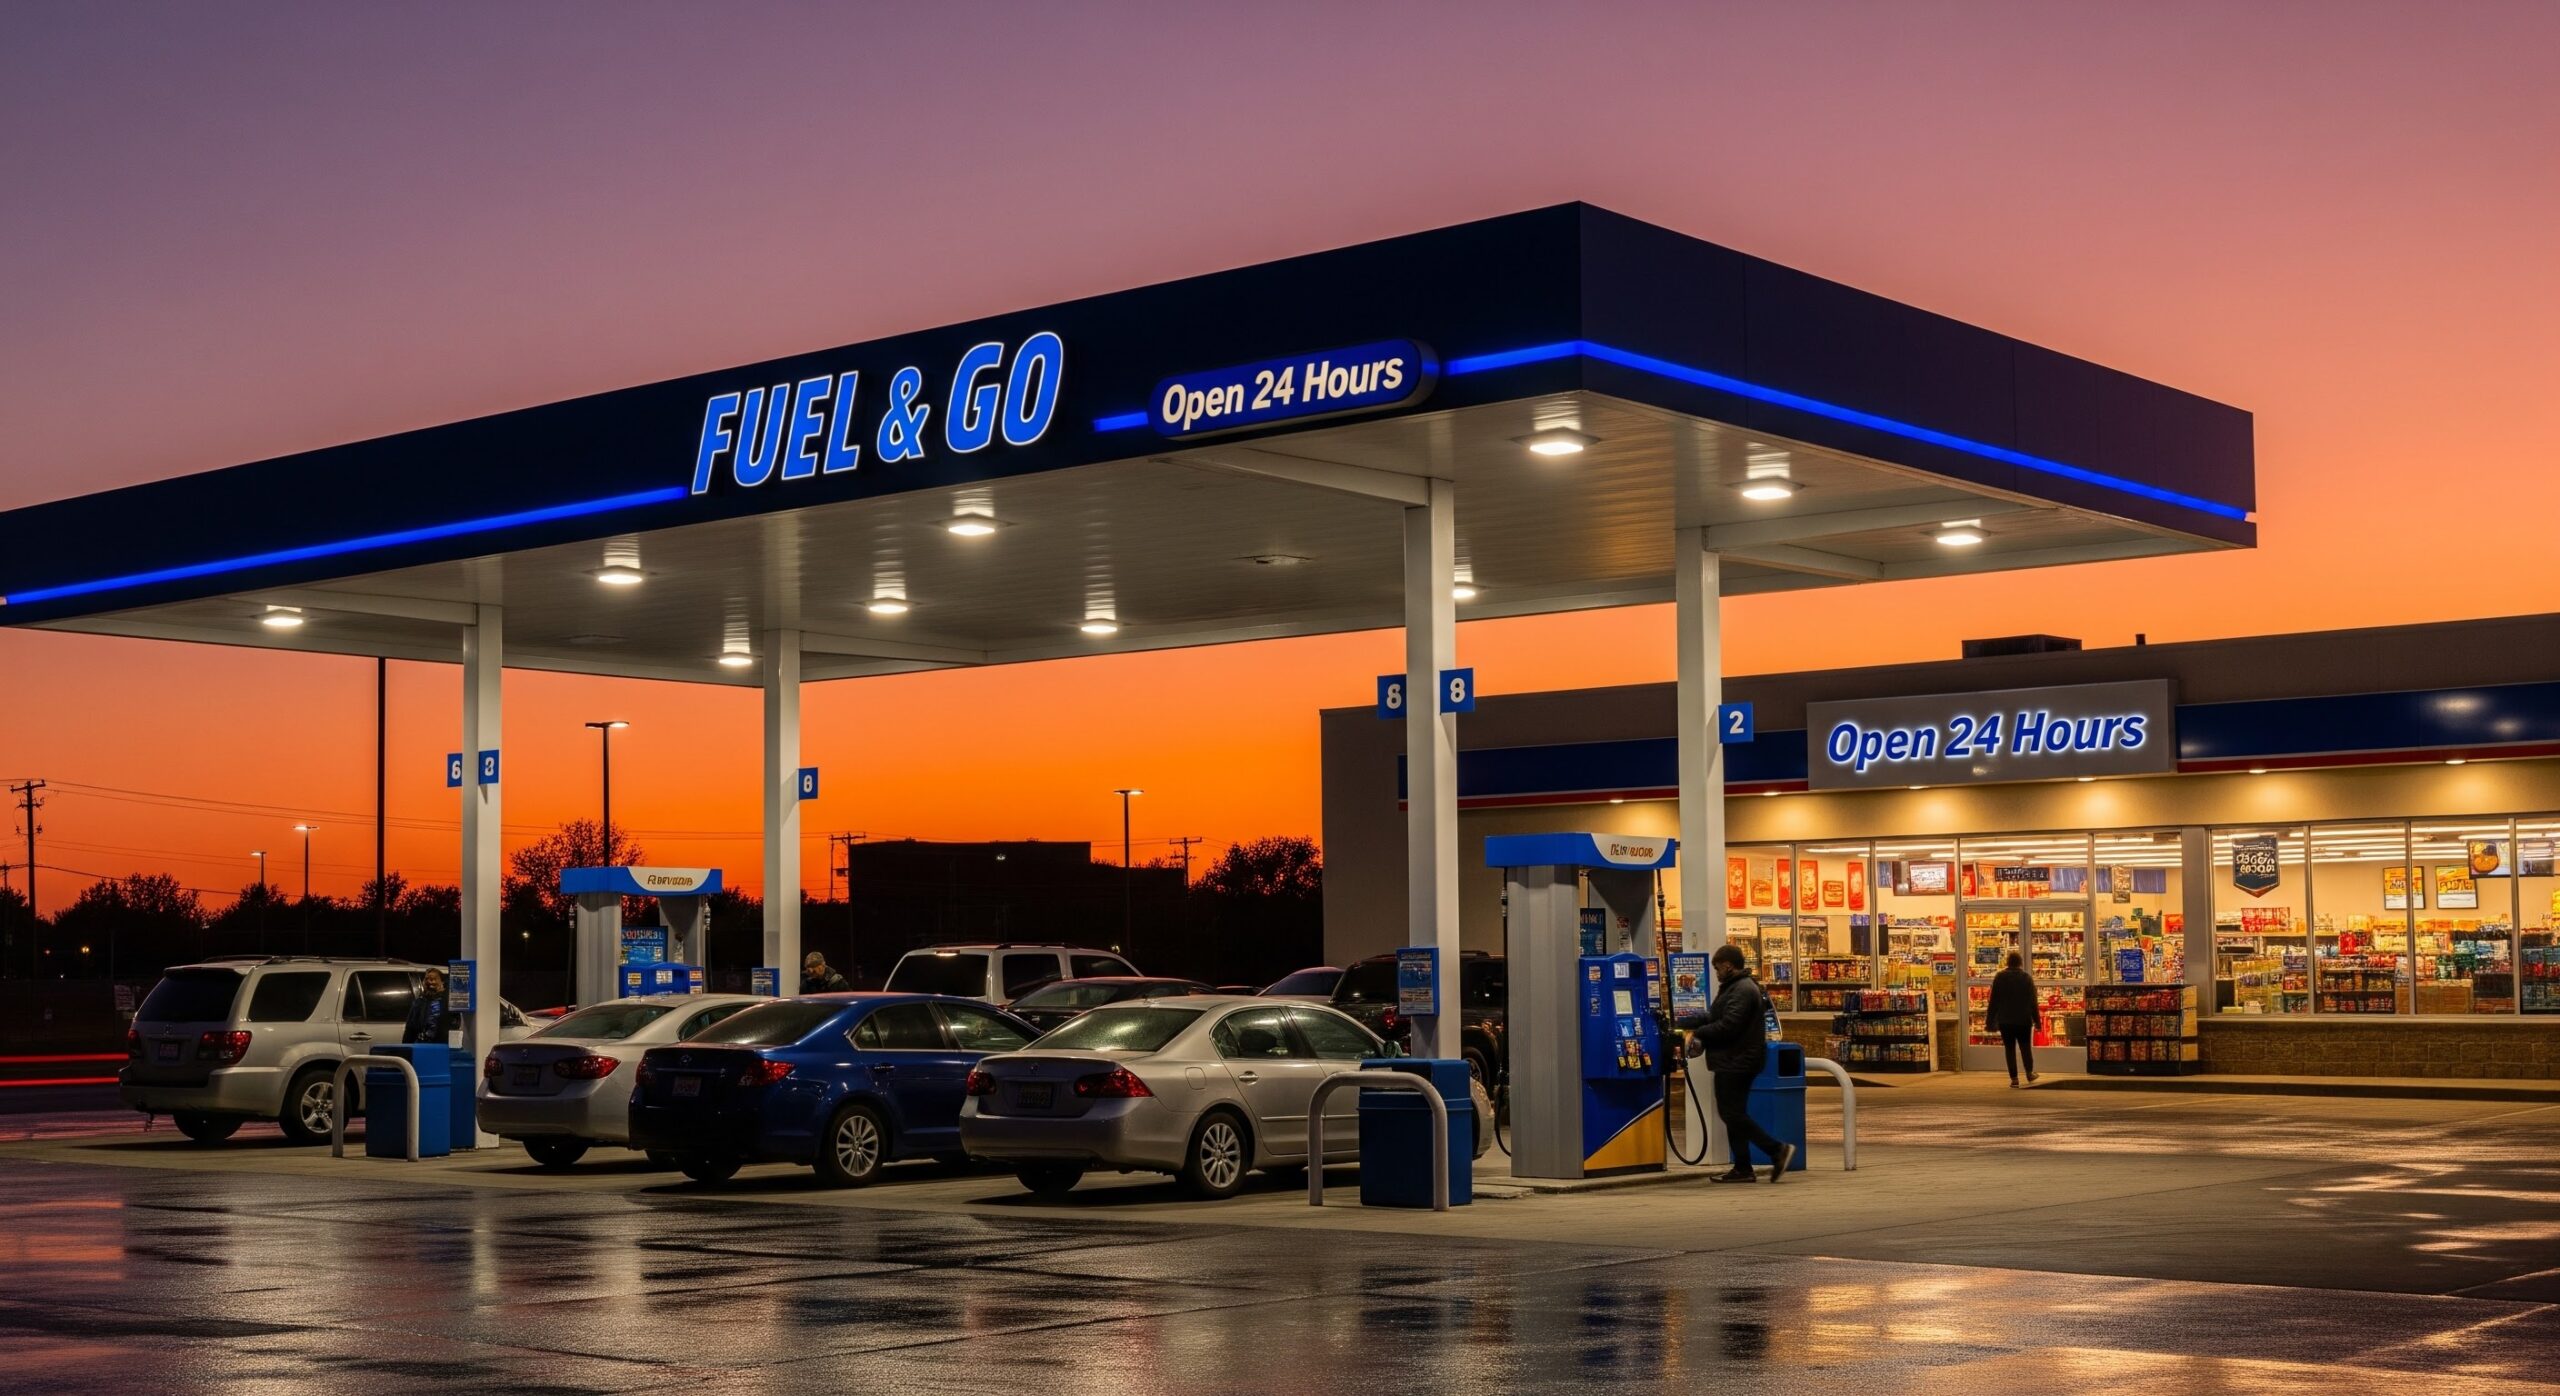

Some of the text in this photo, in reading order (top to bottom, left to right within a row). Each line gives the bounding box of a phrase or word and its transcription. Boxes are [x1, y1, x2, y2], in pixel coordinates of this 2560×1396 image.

[692, 331, 1064, 496] FUEL & GO
[1162, 357, 1404, 431] Open 24 Hours
[1450, 677, 1466, 703] 8
[1729, 710, 1744, 734] 2
[1827, 711, 2147, 772] Open 24 Hours
[451, 760, 461, 780] 6
